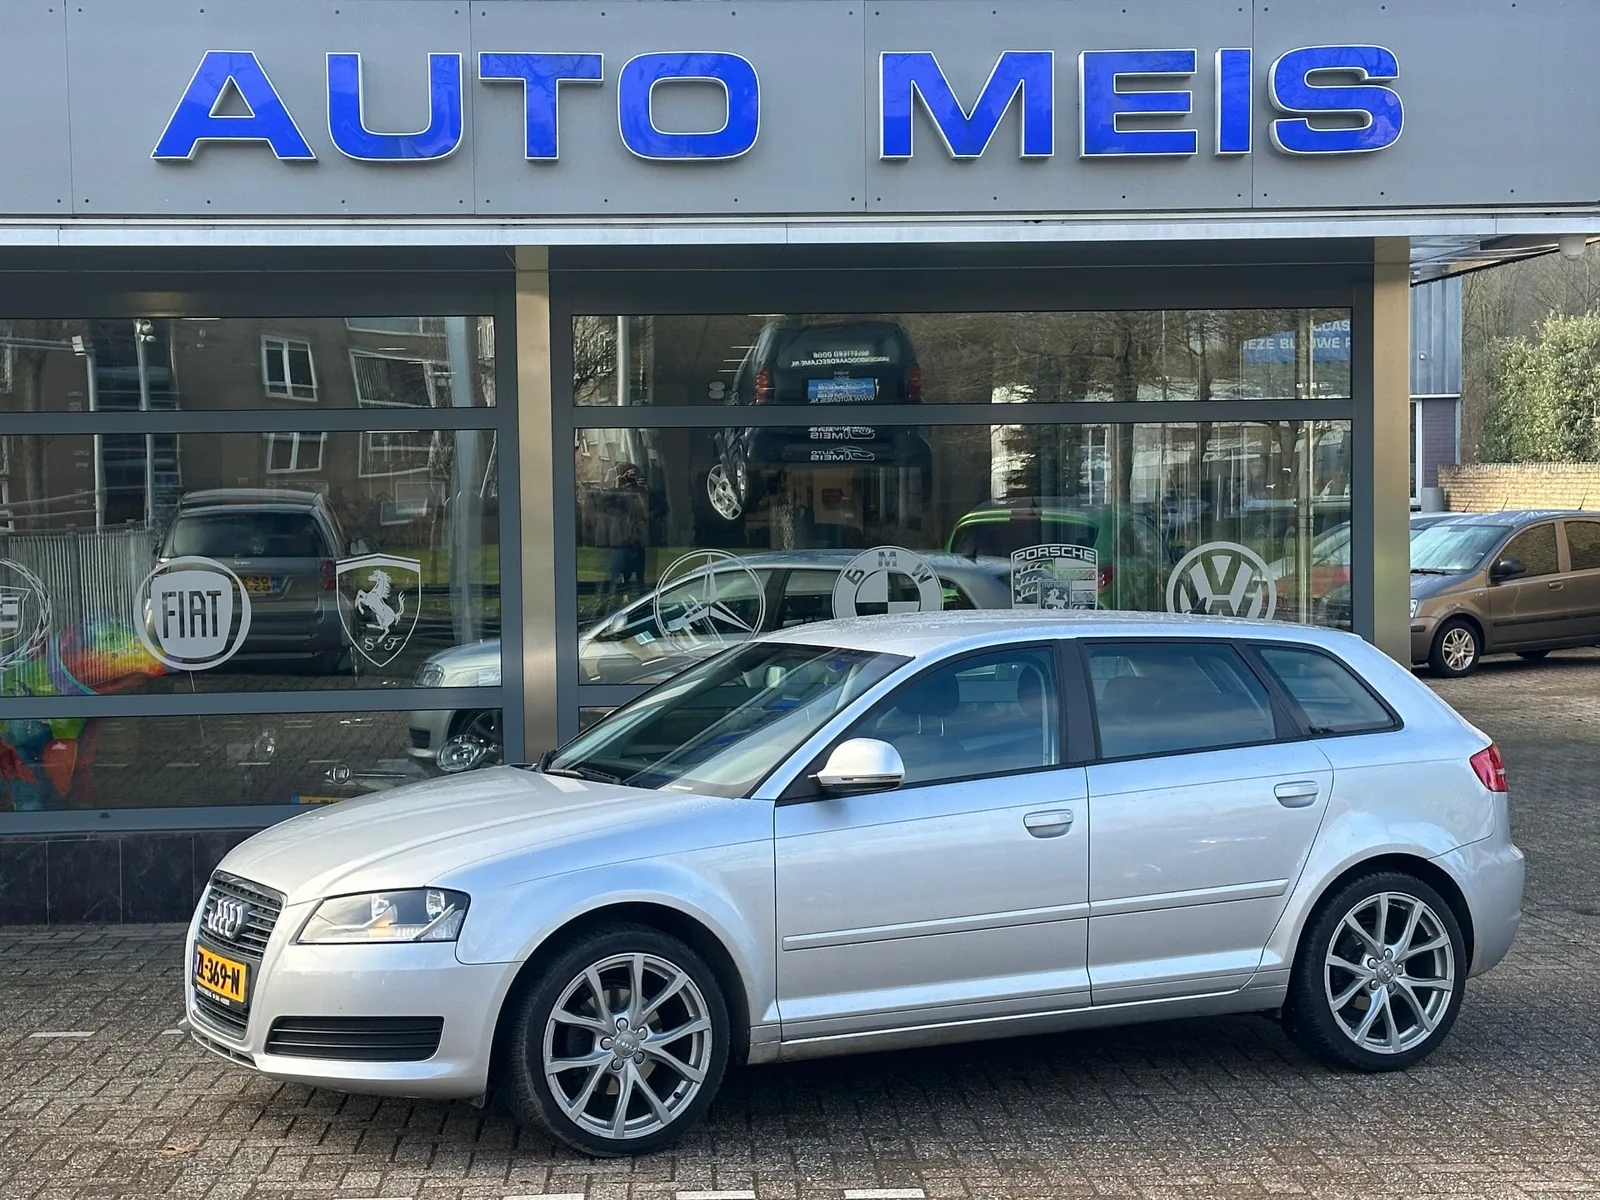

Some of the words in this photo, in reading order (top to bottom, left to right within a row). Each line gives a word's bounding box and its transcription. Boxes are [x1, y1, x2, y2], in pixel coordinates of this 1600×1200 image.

[150, 50, 761, 162] AUTO
[878, 43, 1406, 161] MEIS
[1014, 546, 1096, 564] PORSCHE
[161, 590, 222, 639] FIAT
